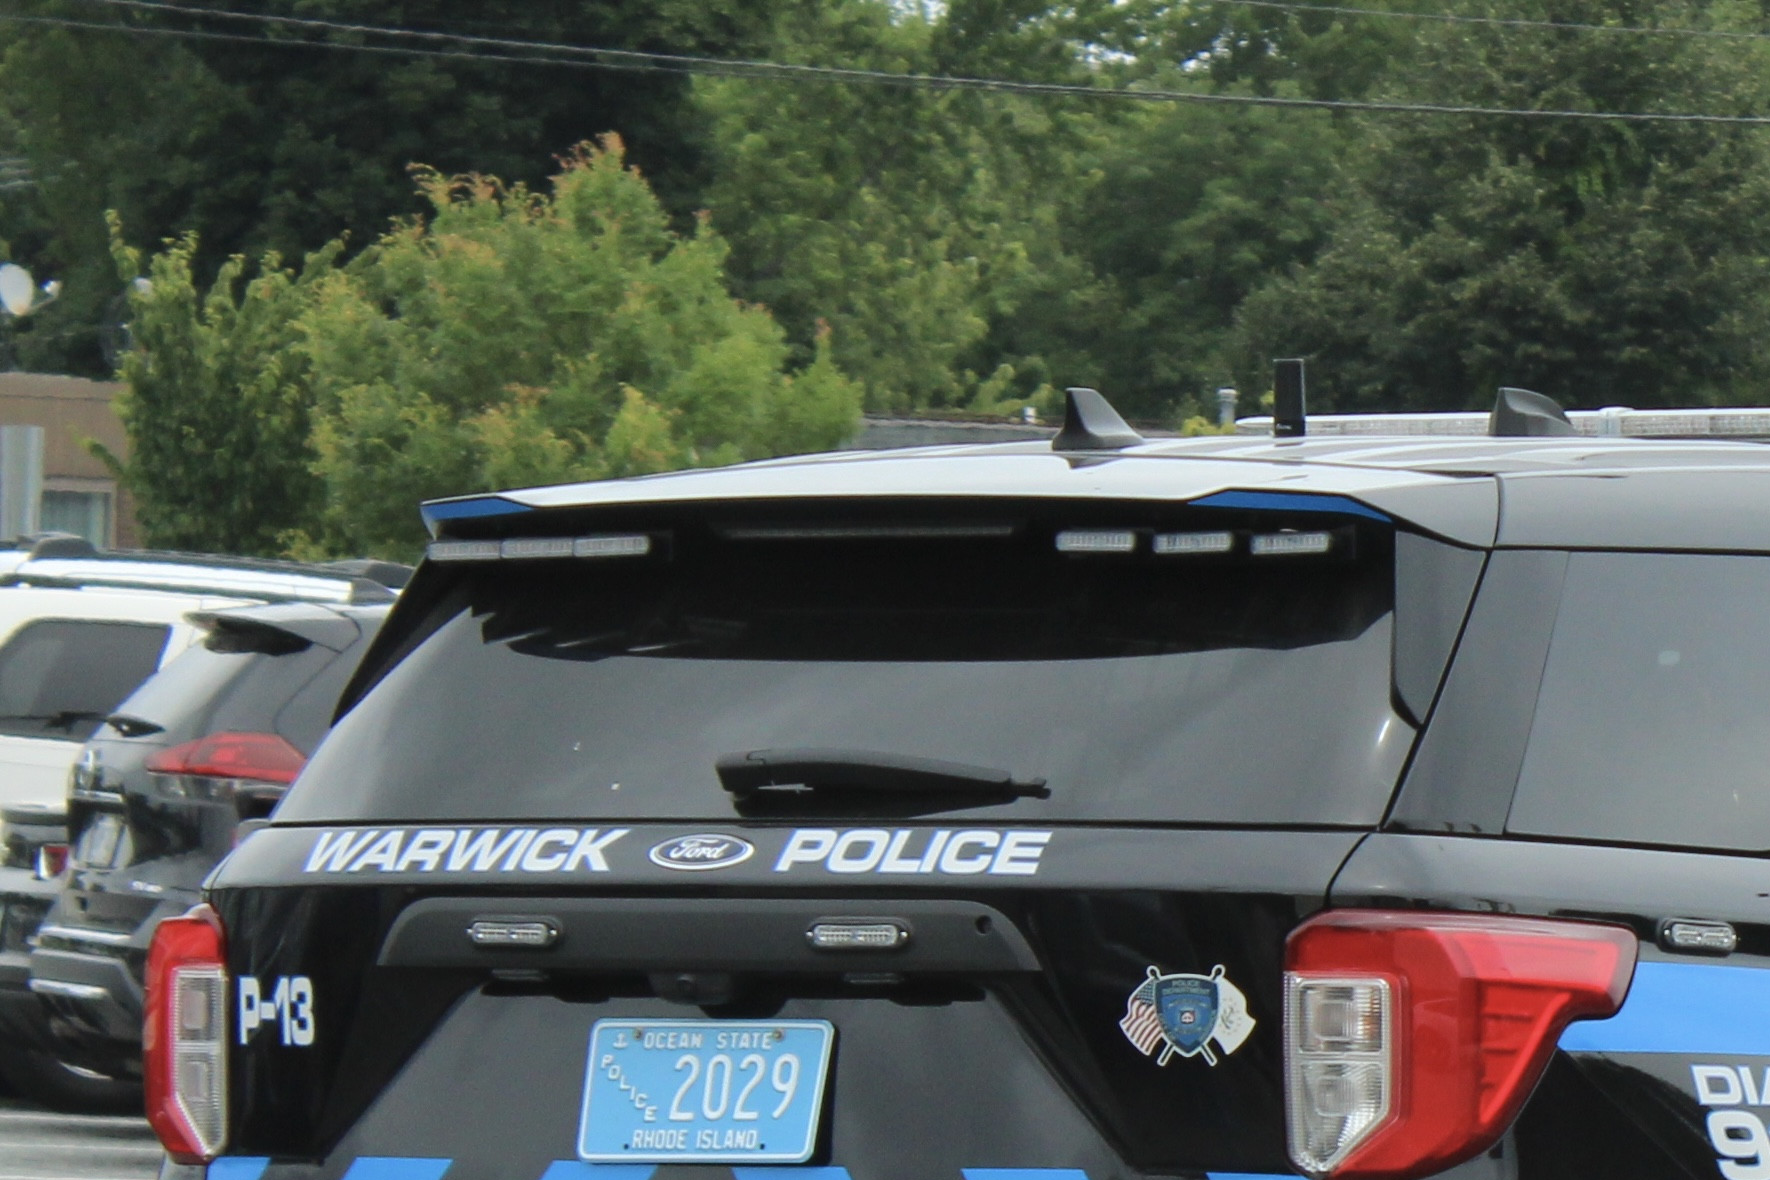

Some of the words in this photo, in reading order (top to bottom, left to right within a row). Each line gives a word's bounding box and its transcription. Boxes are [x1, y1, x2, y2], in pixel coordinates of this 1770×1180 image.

[304, 829, 631, 873] WARWICK
[668, 837, 730, 861] Ford
[774, 829, 1053, 874] POLICE
[236, 975, 315, 1046] P-13
[643, 1031, 702, 1050] OCEAN
[716, 1031, 773, 1050] STATE
[600, 1054, 658, 1122] POLICE
[668, 1053, 800, 1121] 2029
[631, 1129, 689, 1150] RHODE
[696, 1129, 758, 1150] ISLAND
